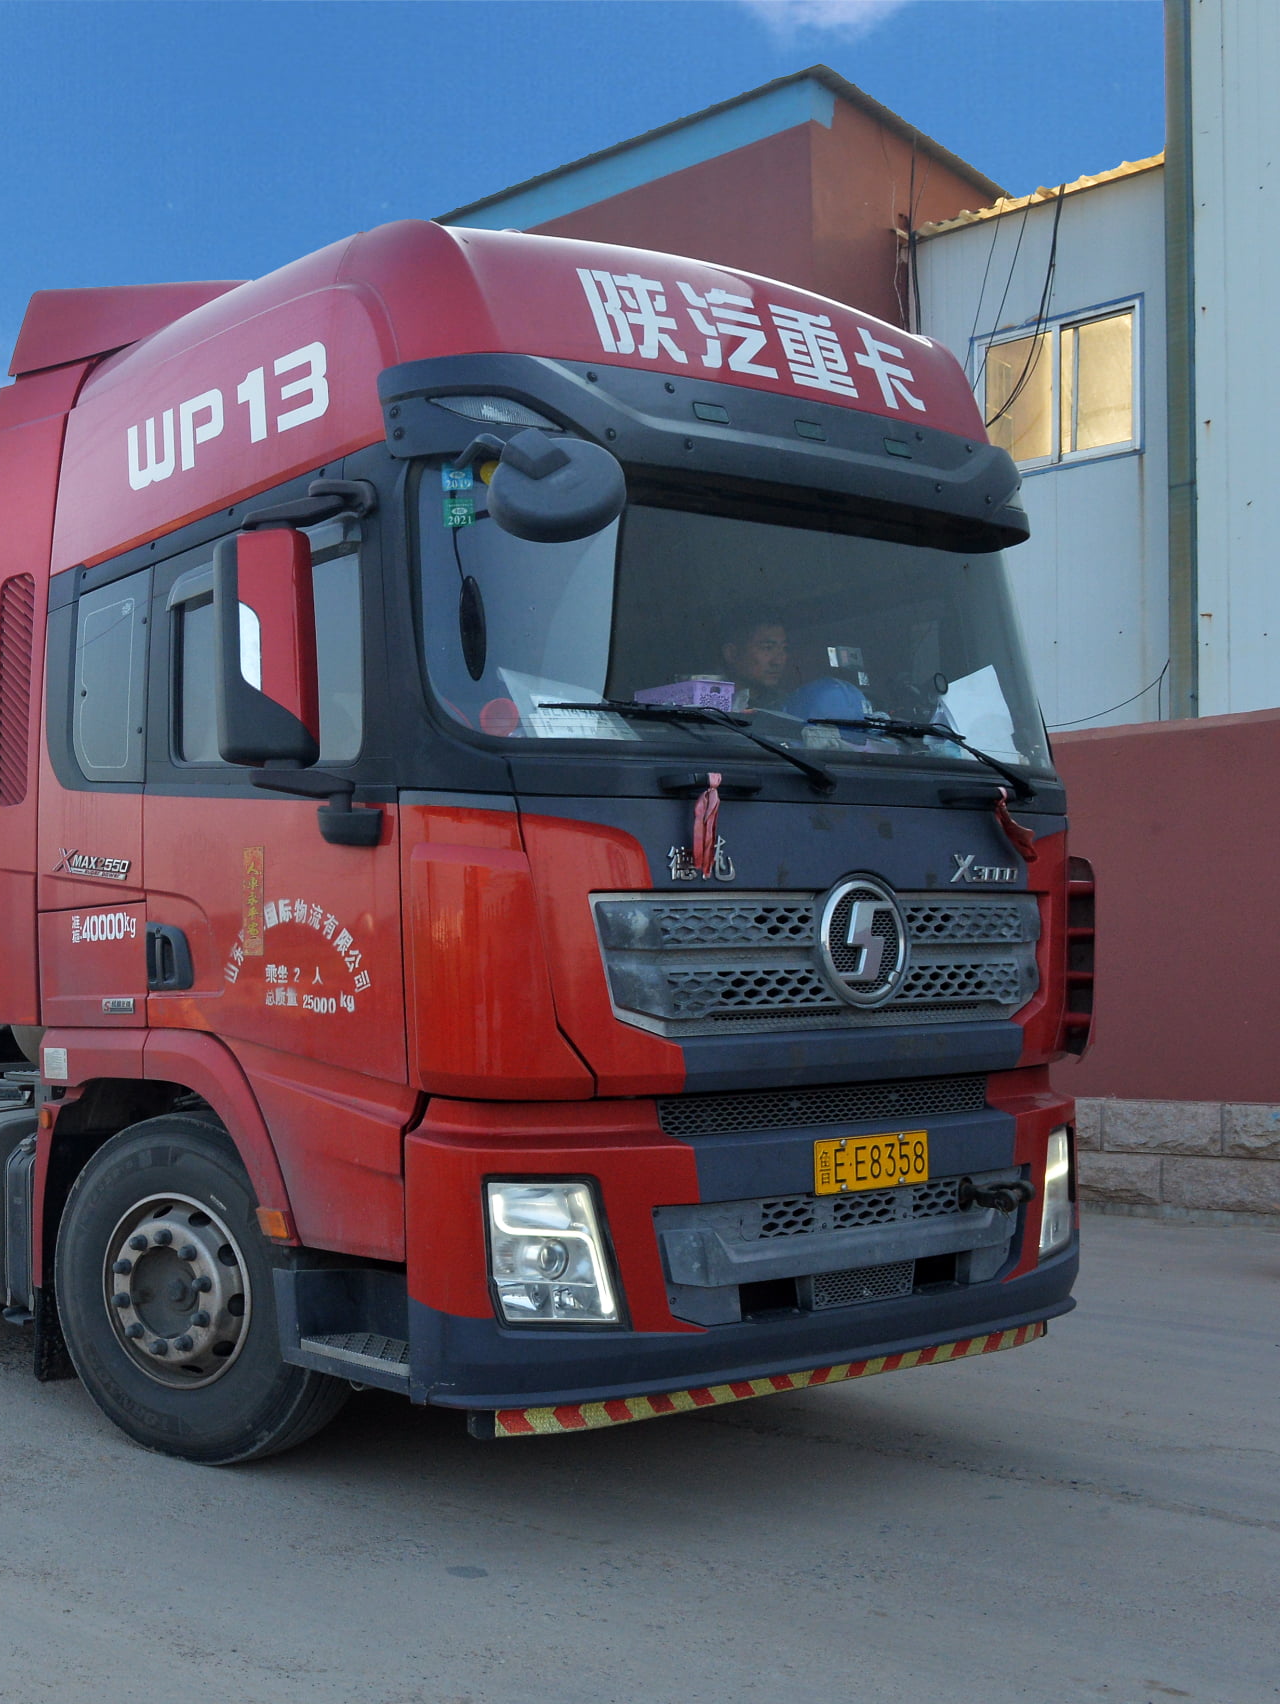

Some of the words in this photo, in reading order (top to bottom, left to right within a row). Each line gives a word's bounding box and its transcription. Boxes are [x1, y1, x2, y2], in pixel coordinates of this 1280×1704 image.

[576, 268, 926, 411] 陕汽重卡
[448, 515, 472, 525] 2021
[950, 854, 1018, 882] X3000
[293, 967, 301, 983] 2
[312, 966, 324, 985] 人
[265, 986, 298, 1007] 总质量
[302, 993, 337, 1014] 25000
[340, 990, 356, 1013] kg
